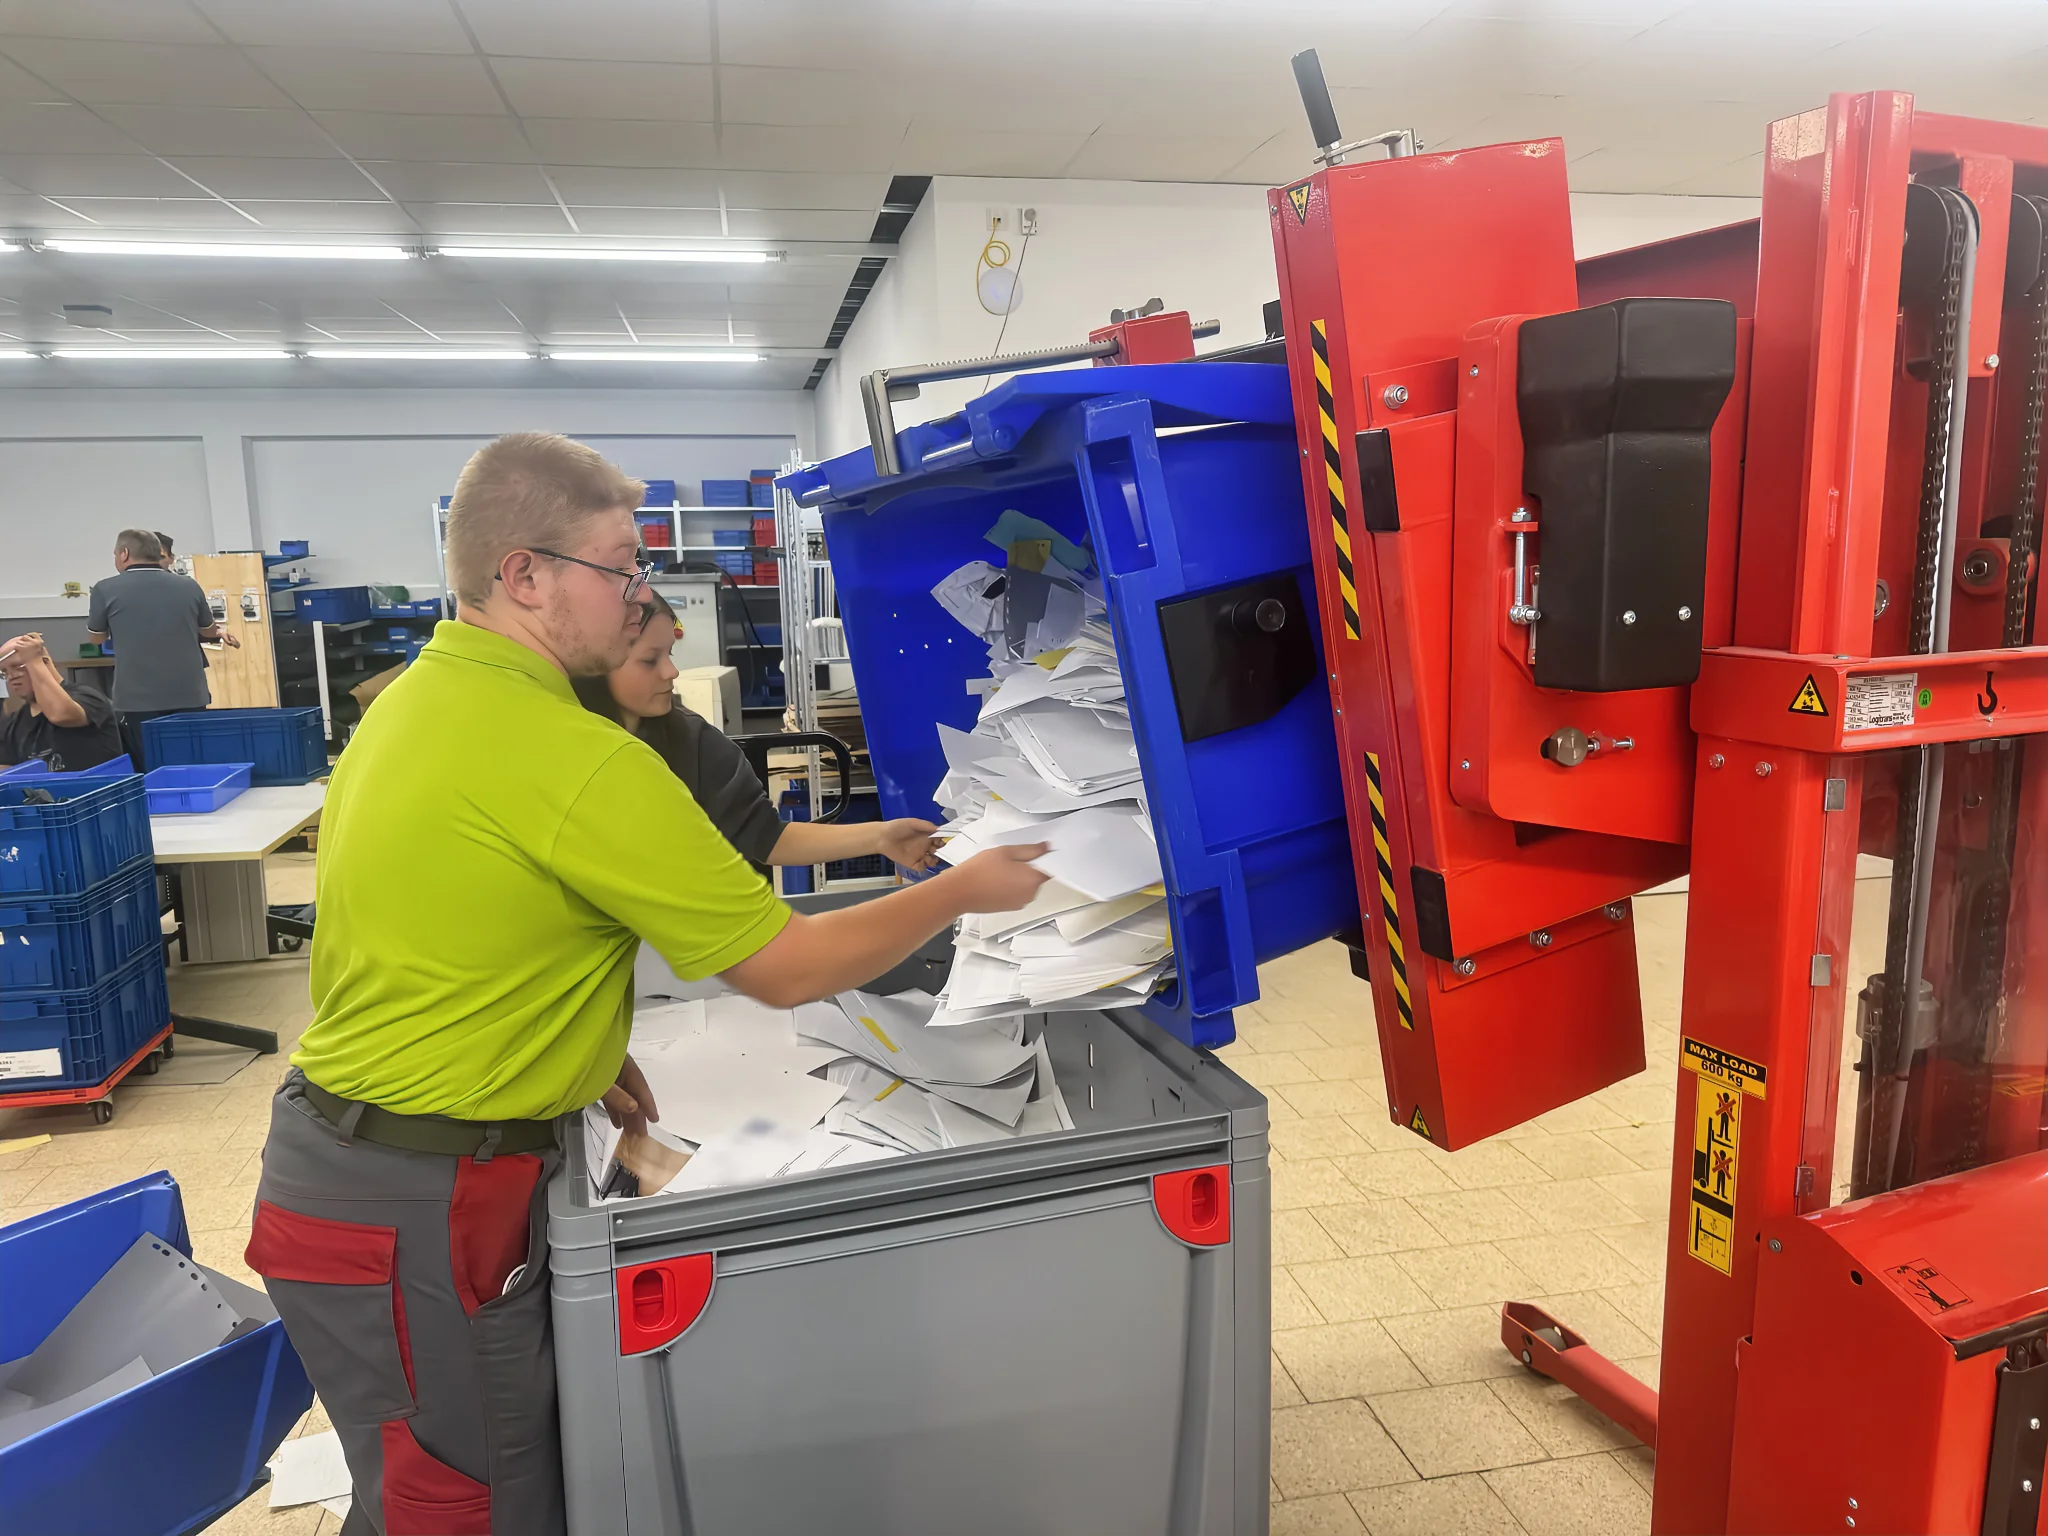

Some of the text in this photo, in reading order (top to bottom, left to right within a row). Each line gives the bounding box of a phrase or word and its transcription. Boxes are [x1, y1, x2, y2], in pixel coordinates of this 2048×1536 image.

[1869, 714, 1892, 726] Logitrans
[1690, 1043, 1758, 1076] MAX LOAD
[1701, 1060, 1743, 1088] 600 kg
